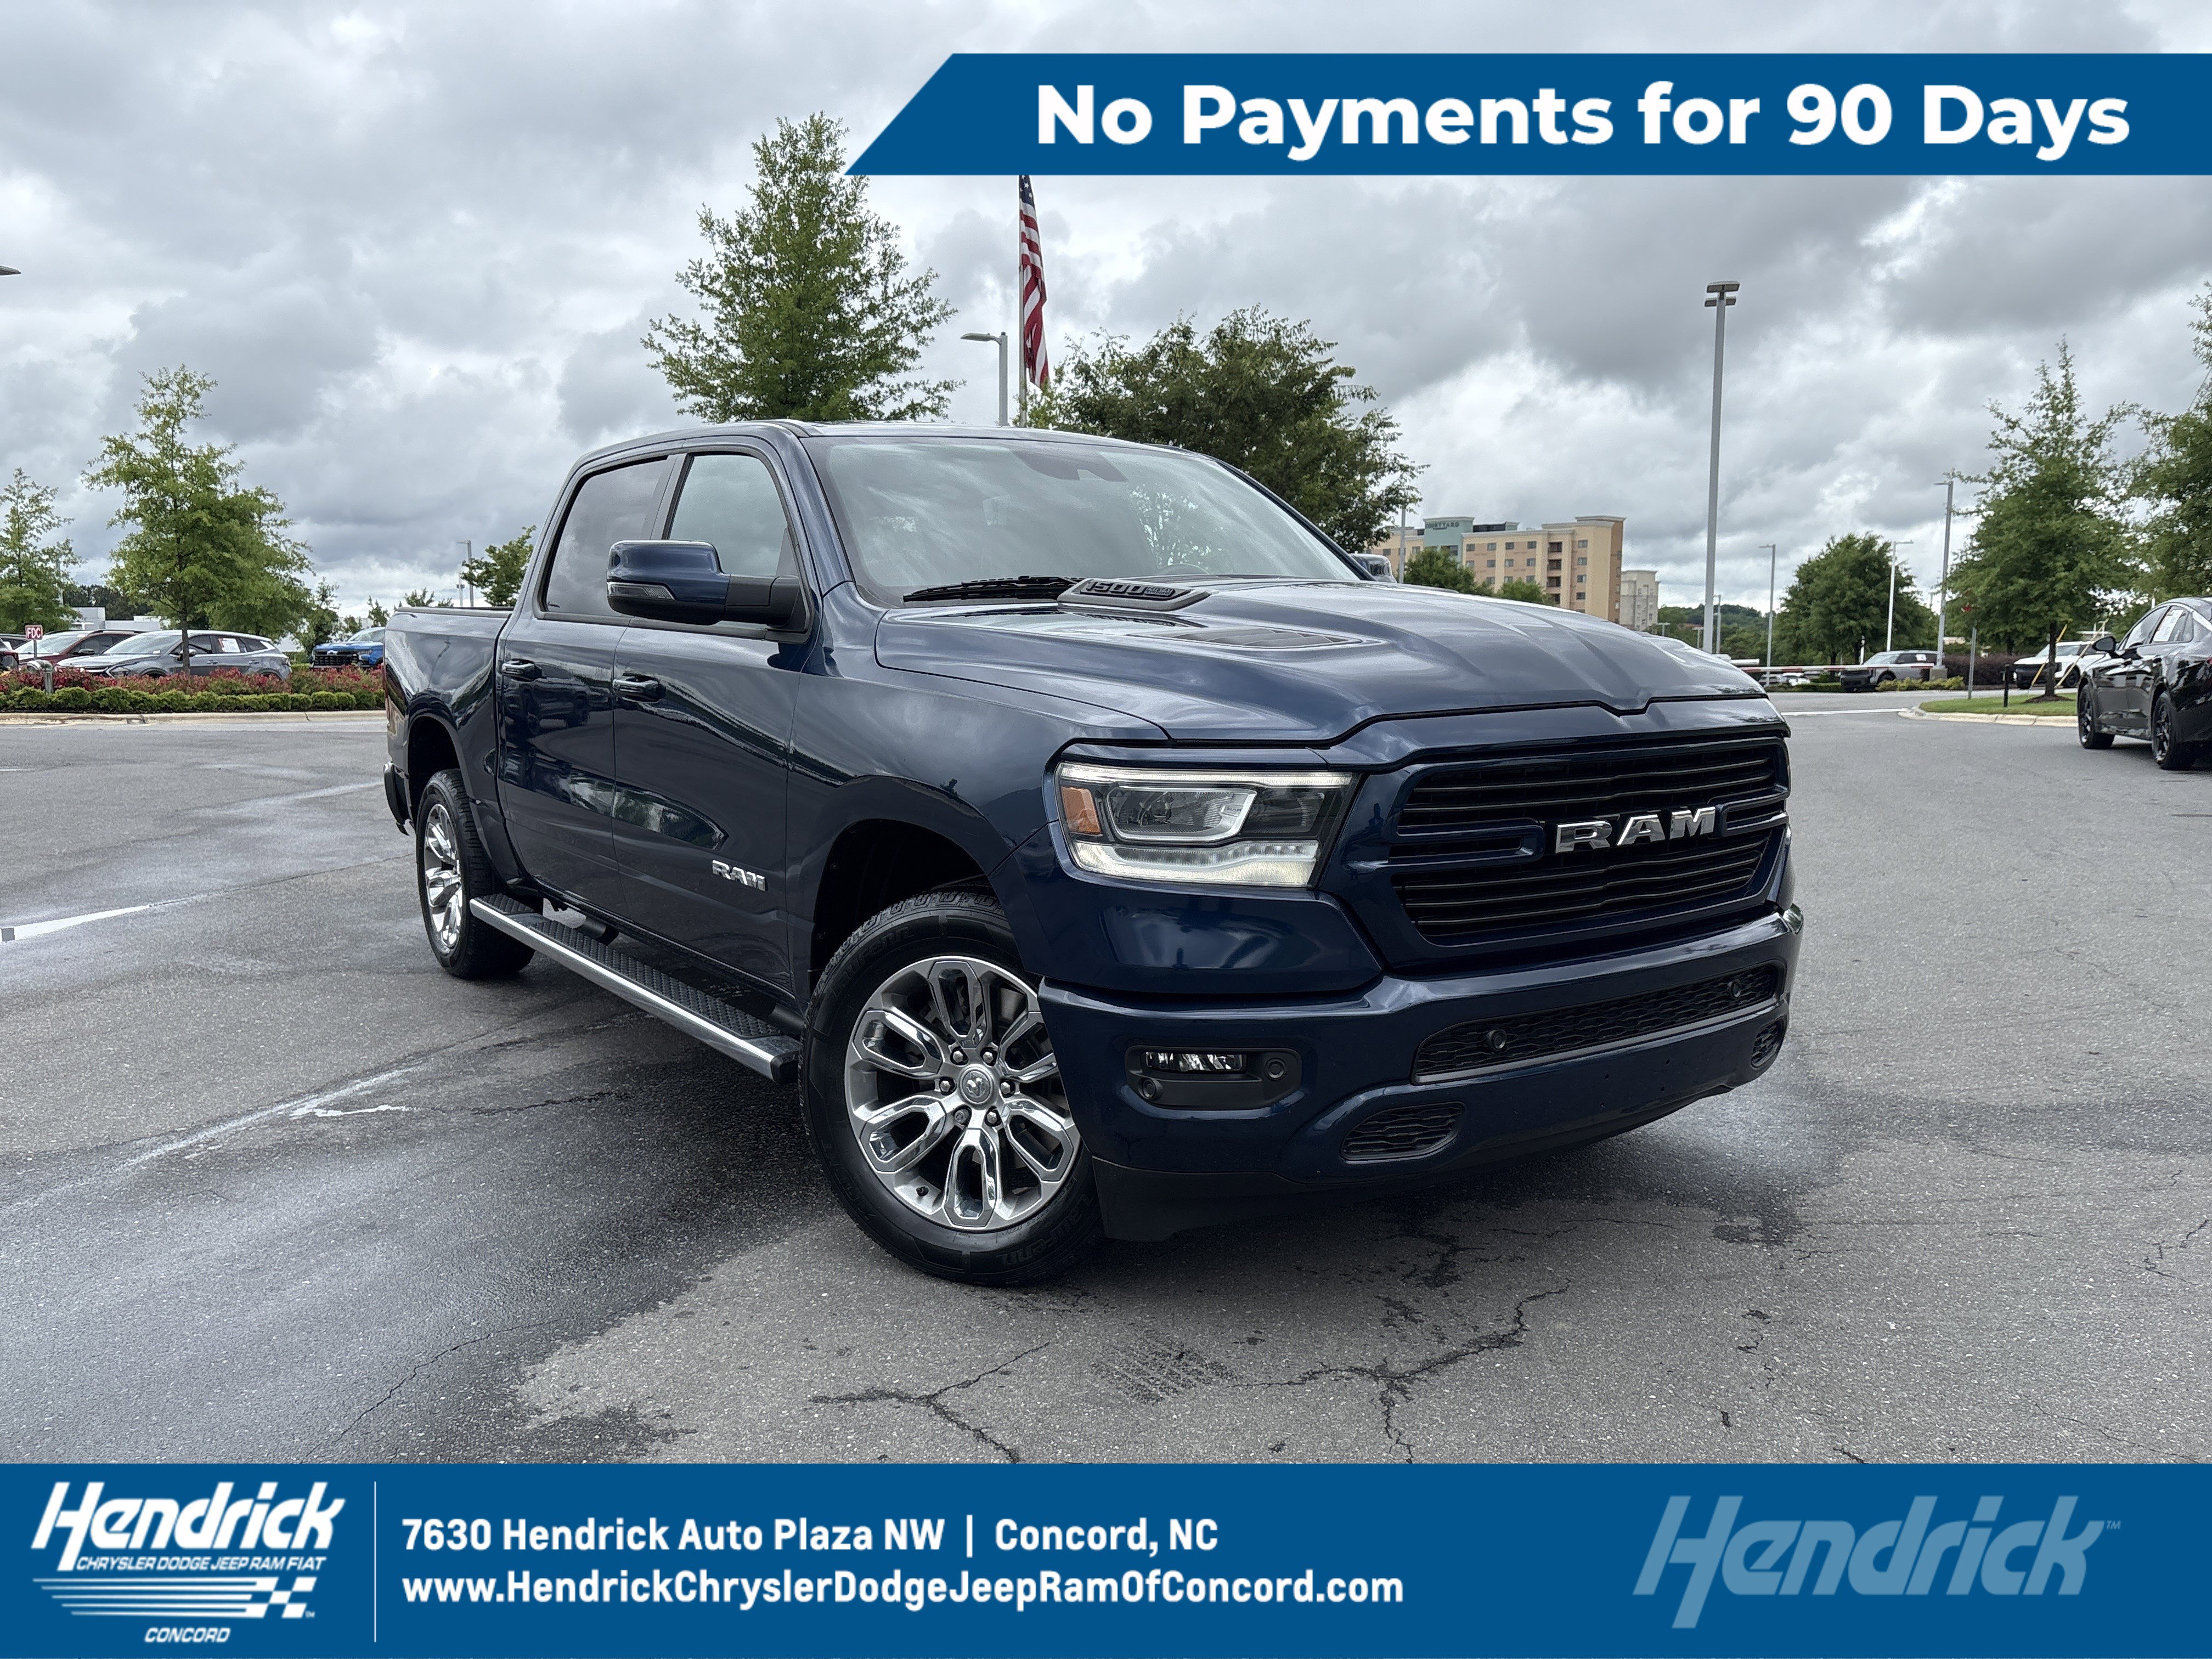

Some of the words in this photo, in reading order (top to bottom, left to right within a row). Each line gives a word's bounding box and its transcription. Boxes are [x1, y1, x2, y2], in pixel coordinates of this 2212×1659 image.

[1086, 580, 1147, 594] 1500
[27, 627, 41, 639] FDC
[1555, 806, 1716, 854] RAM
[712, 860, 766, 892] RAM
